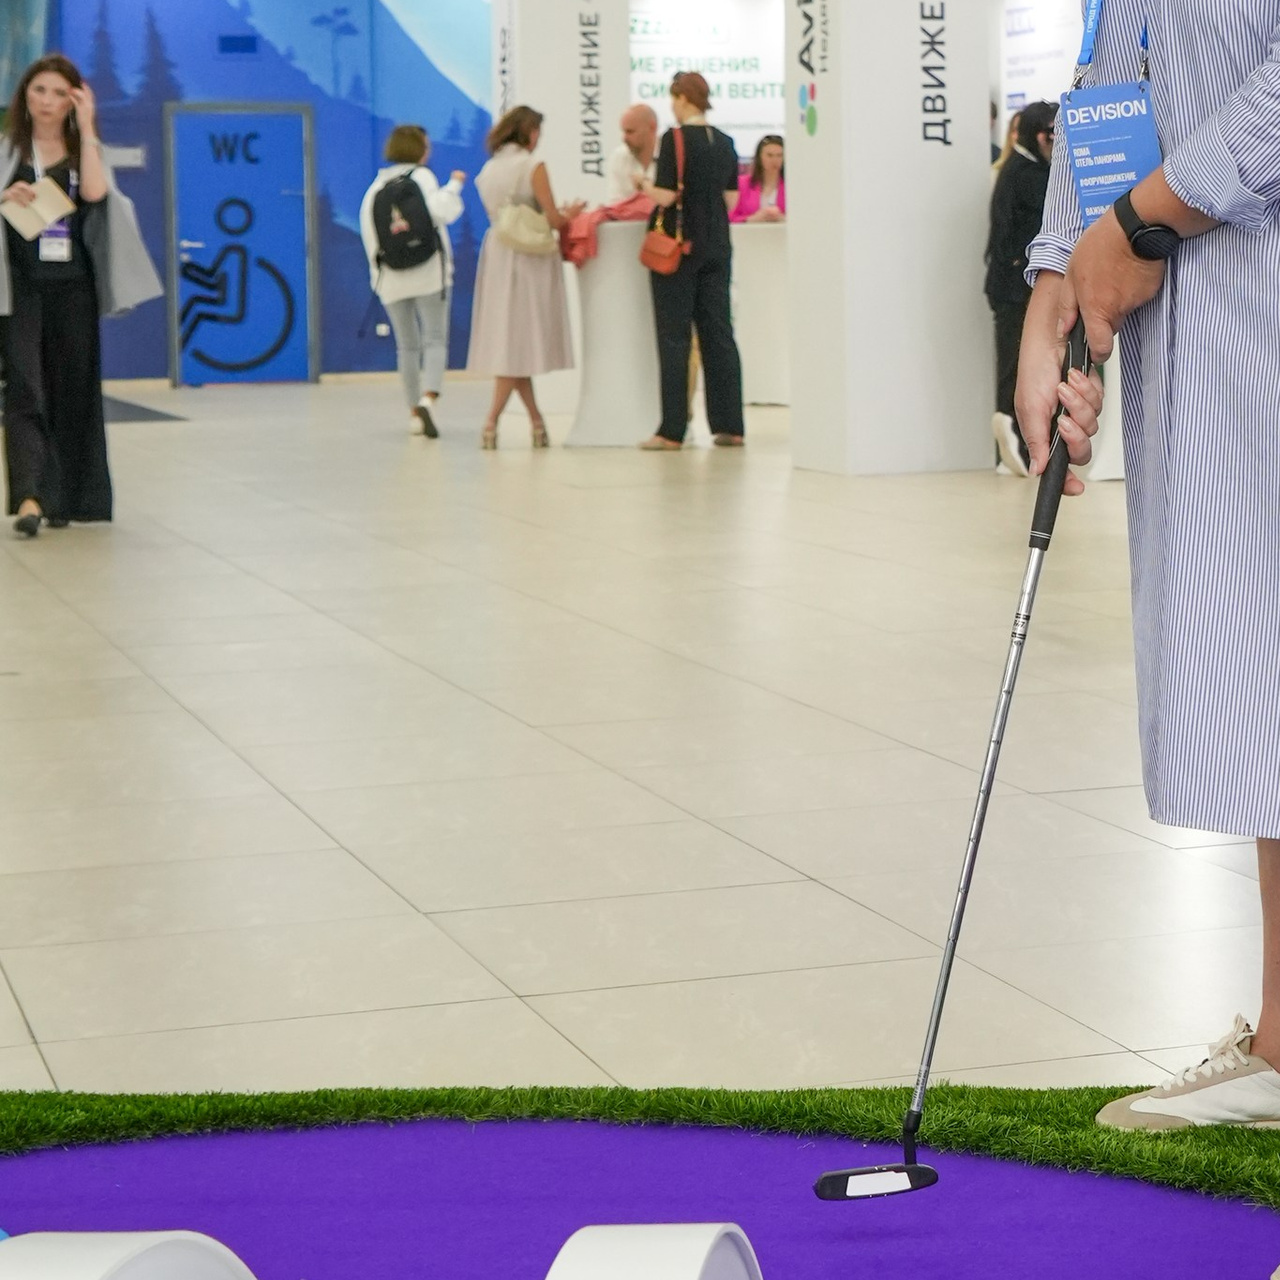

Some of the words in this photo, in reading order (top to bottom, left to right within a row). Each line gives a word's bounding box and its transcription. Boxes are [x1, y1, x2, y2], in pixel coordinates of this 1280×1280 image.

[662, 56, 760, 72] РЕШЕНИЯ
[578, 11, 605, 178] ДВИЖЕНИЕ
[1066, 99, 1147, 125] DEVISION
[209, 131, 260, 165] WC
